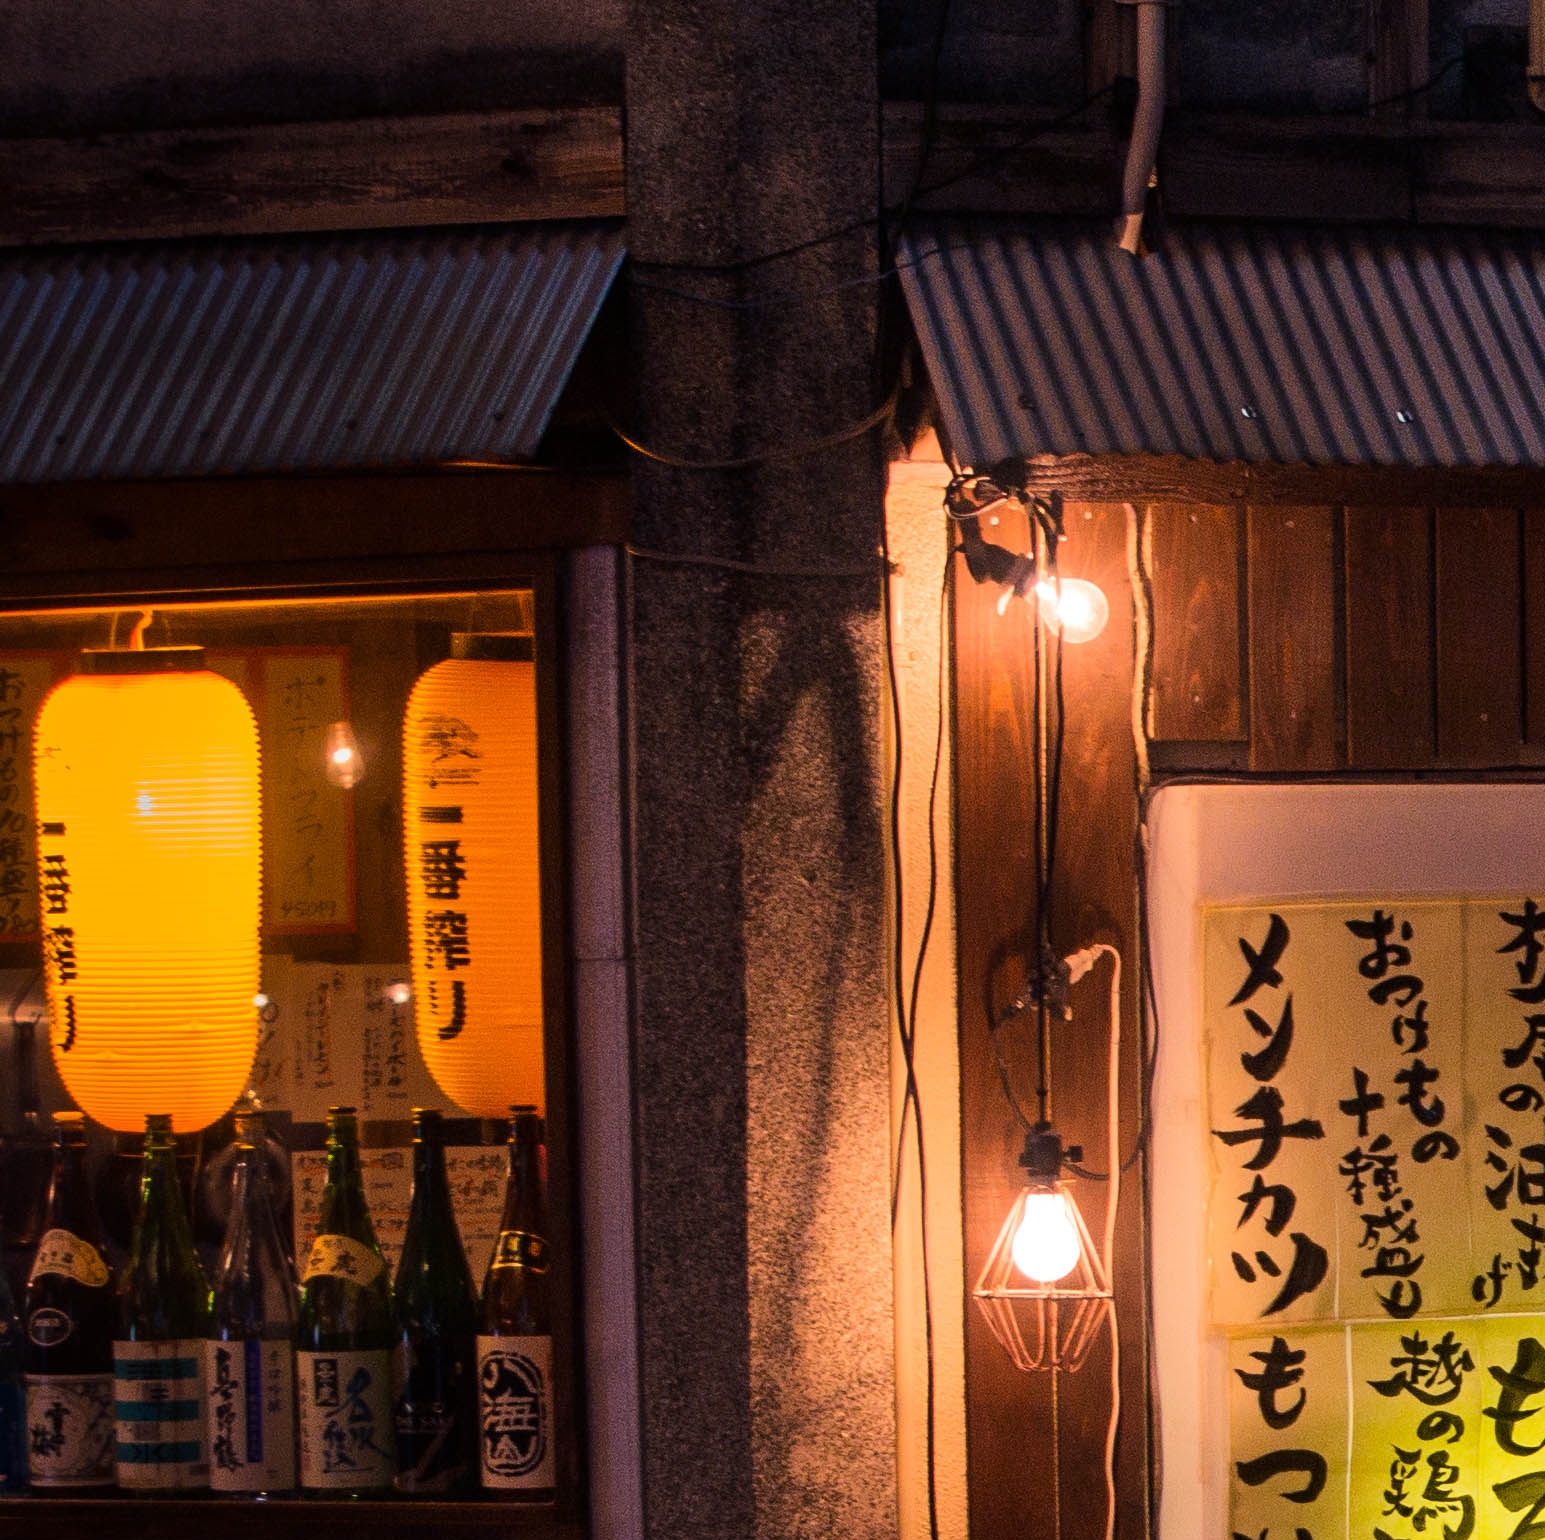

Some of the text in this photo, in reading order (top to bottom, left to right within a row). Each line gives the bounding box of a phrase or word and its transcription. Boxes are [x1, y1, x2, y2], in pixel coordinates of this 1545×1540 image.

[1211, 913, 1328, 1318] メンチカツ
[1346, 908, 1460, 1165] おつけもの
[1338, 1069, 1424, 1319] 十種盛り
